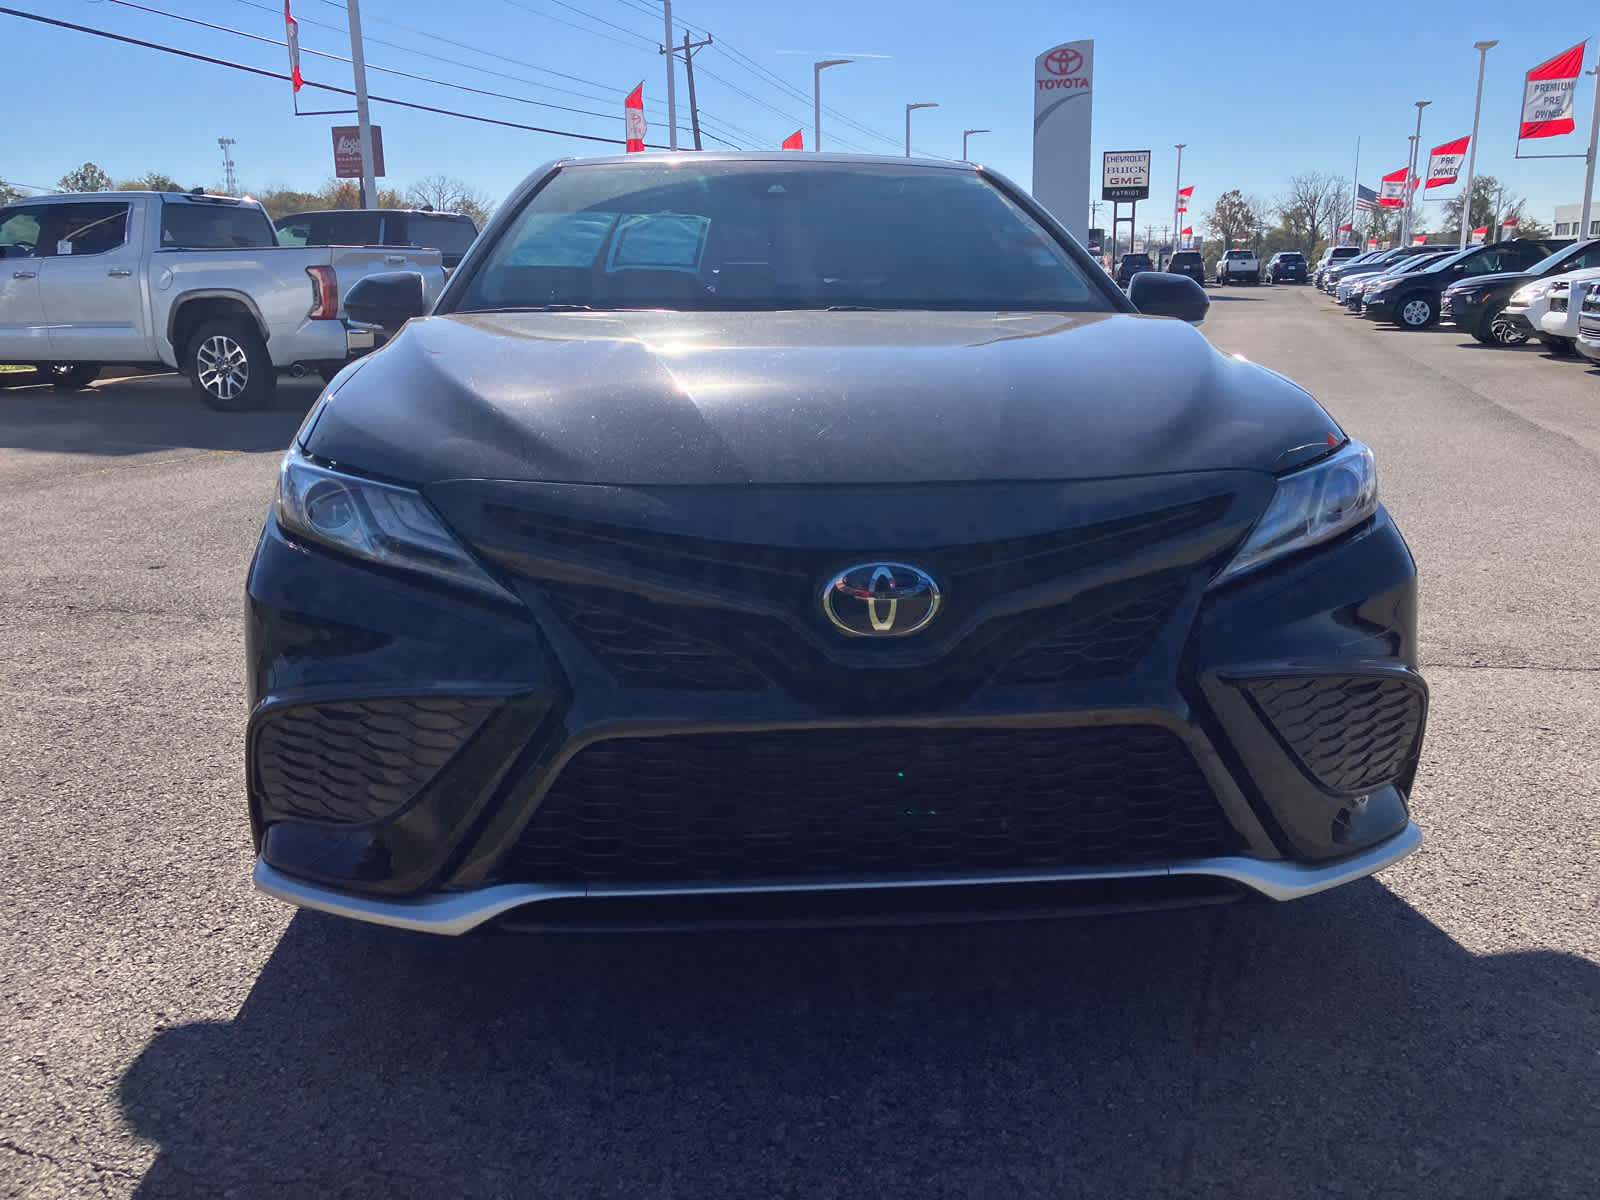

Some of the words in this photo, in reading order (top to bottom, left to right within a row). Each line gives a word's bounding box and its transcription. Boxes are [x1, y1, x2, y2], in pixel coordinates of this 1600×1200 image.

[1037, 77, 1090, 90] TOYOTA
[1534, 81, 1576, 93] PREMIUM
[1543, 95, 1561, 105] PRE
[1106, 155, 1147, 163] CHEVROLET
[1440, 156, 1456, 165] PRE
[1106, 166, 1147, 175] BUICK
[1433, 167, 1458, 177] OWNED
[1109, 177, 1143, 185] GMC
[1111, 189, 1140, 197] PATRIOT
